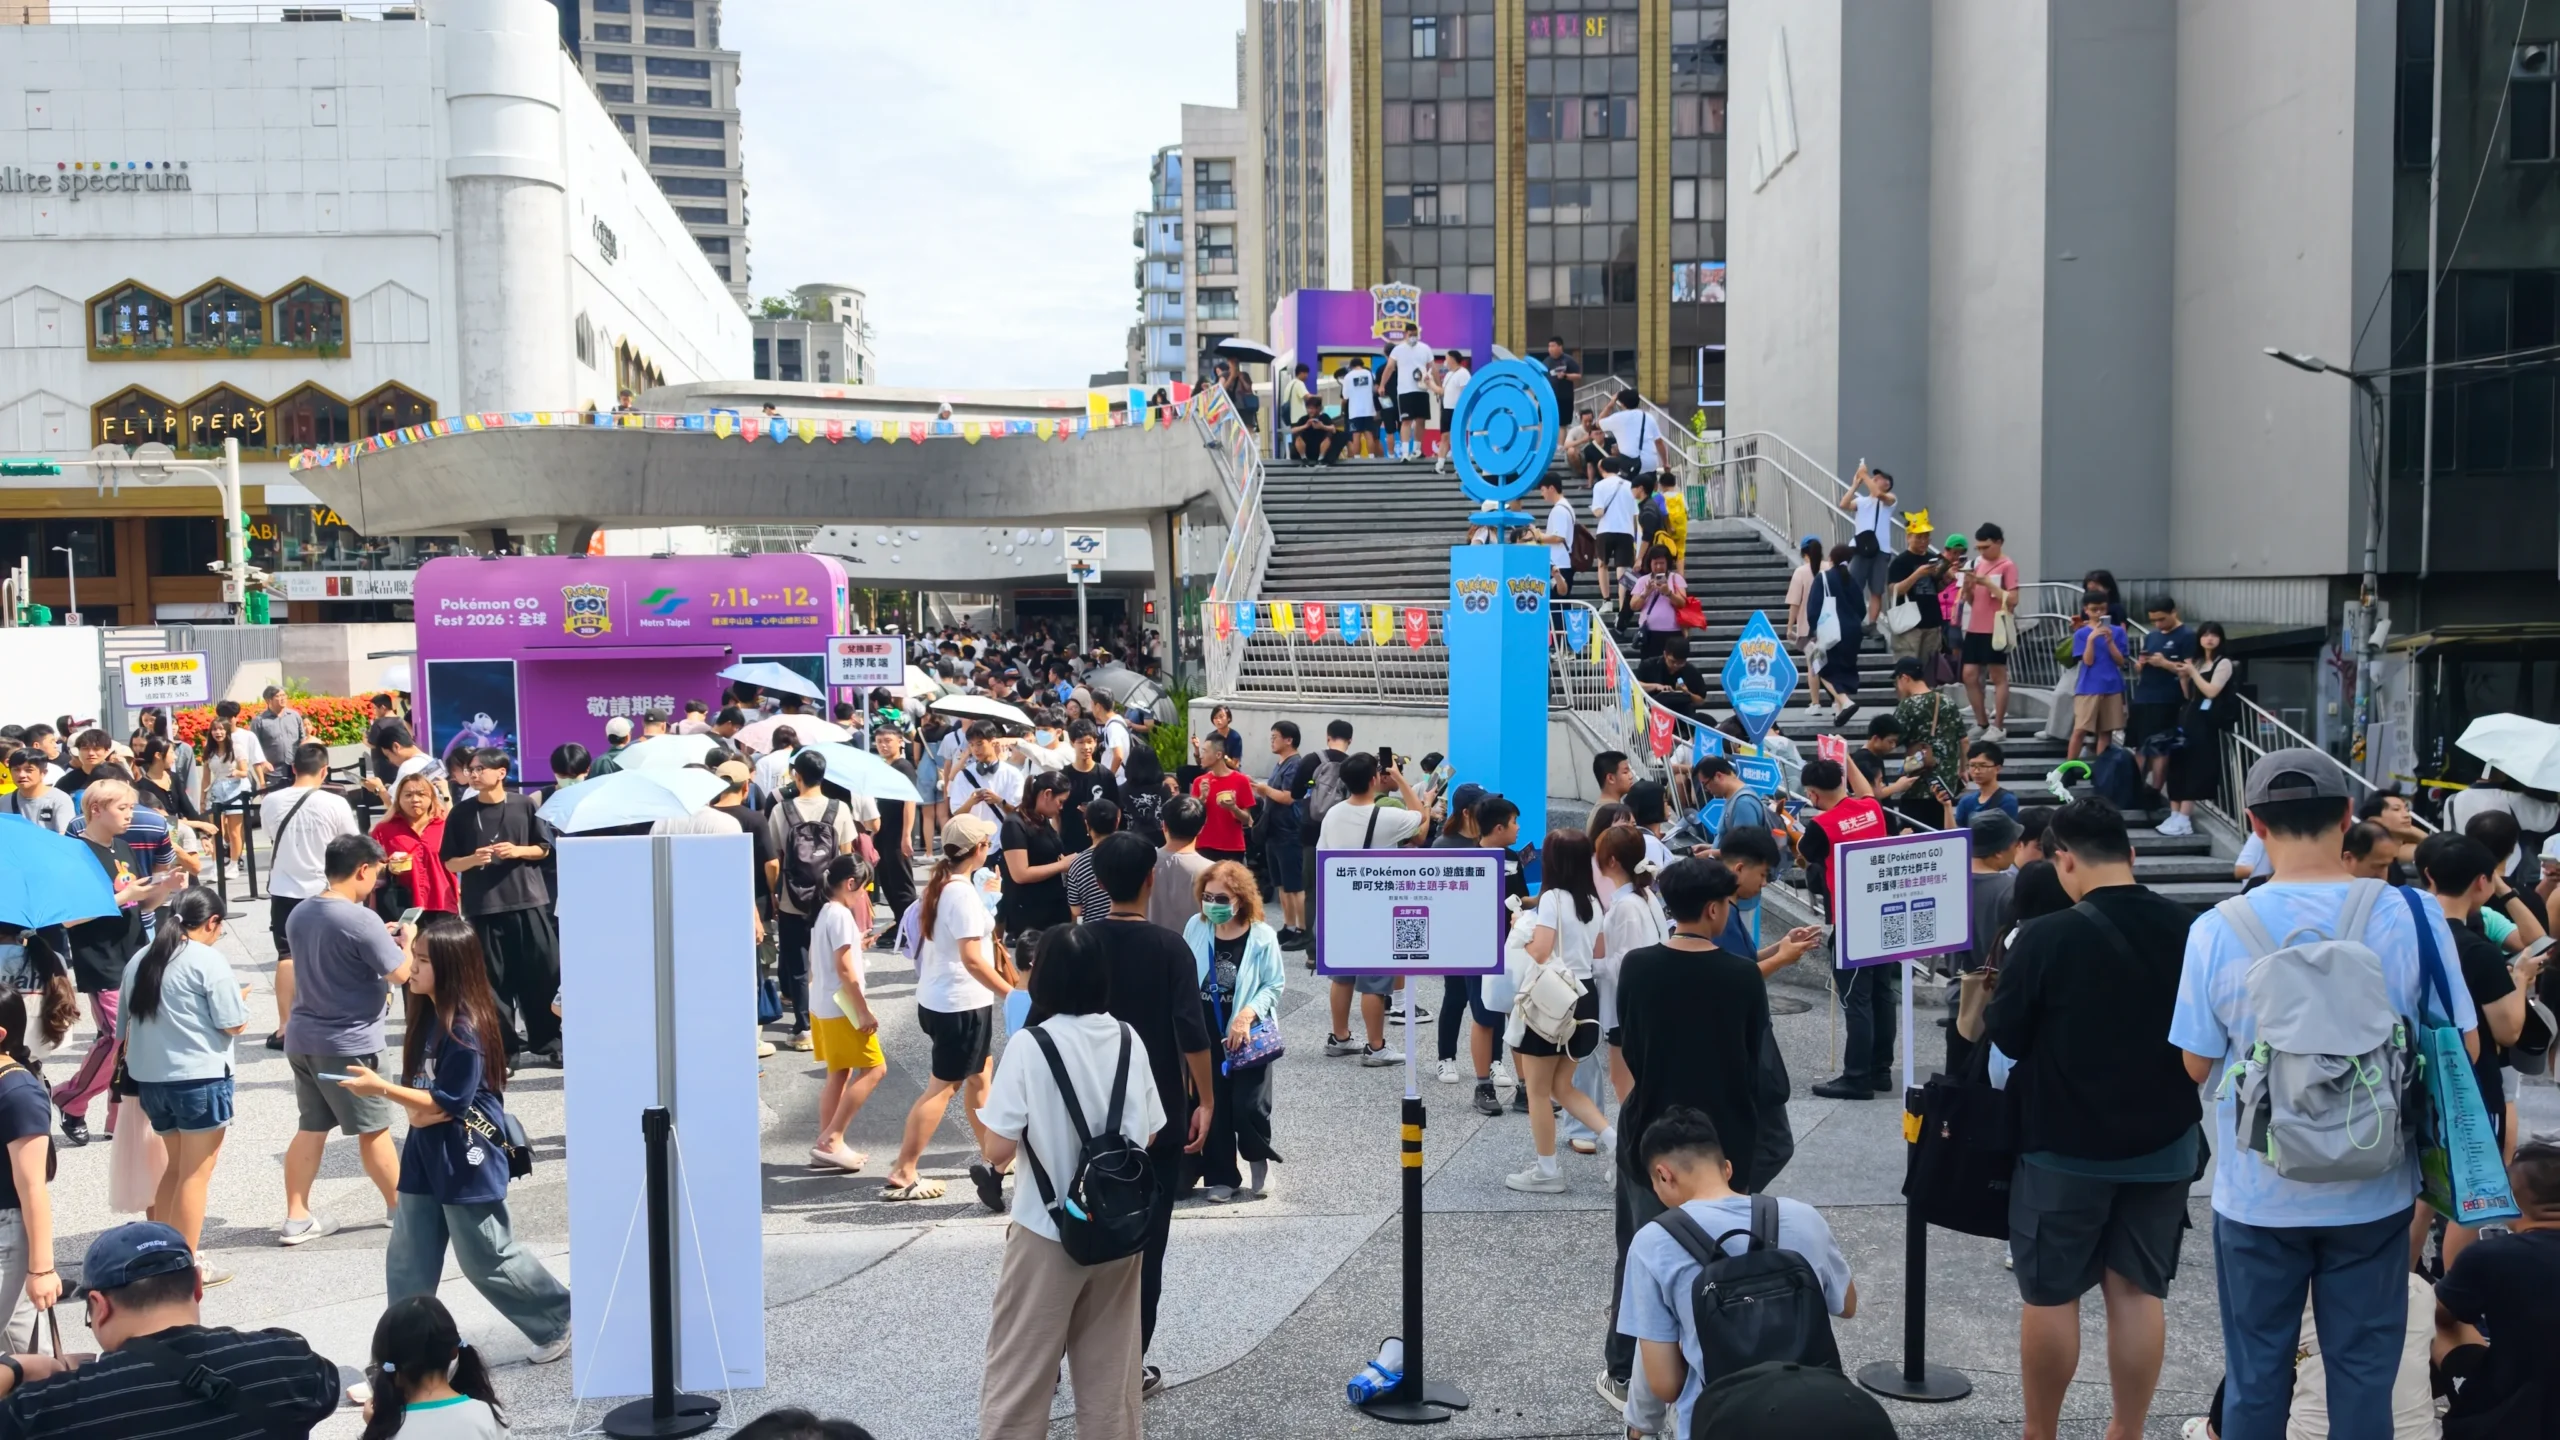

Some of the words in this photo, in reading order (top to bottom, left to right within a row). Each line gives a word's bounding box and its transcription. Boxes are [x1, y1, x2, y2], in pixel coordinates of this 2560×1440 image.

[57, 171, 192, 202] spectrum
[1383, 300, 1410, 315] GO
[120, 320, 150, 332] 生活
[1383, 321, 1405, 330] FES
[102, 410, 266, 441] FLIPPER'S
[440, 597, 511, 611] Pokémon
[513, 598, 539, 610] GO
[710, 588, 749, 607] 7/11
[783, 587, 809, 607] 12
[1464, 595, 1490, 612] GO
[1515, 595, 1539, 612] GO
[573, 598, 600, 612] GO
[434, 614, 464, 627] Fest
[573, 617, 602, 626] FEST
[640, 618, 665, 627] Metro
[666, 618, 691, 628] Taipei
[140, 660, 189, 672] 兌換明信片
[842, 657, 889, 668] 排隊尾端
[1747, 658, 1769, 677] GO
[140, 674, 192, 688] 排隊尾端
[586, 695, 675, 717] 敬請期待
[1837, 810, 1878, 832] 新光三越
[1878, 861, 1938, 878] 台灣官方社群平台
[1351, 880, 1469, 892] 即可兌換活動主題手拿扇
